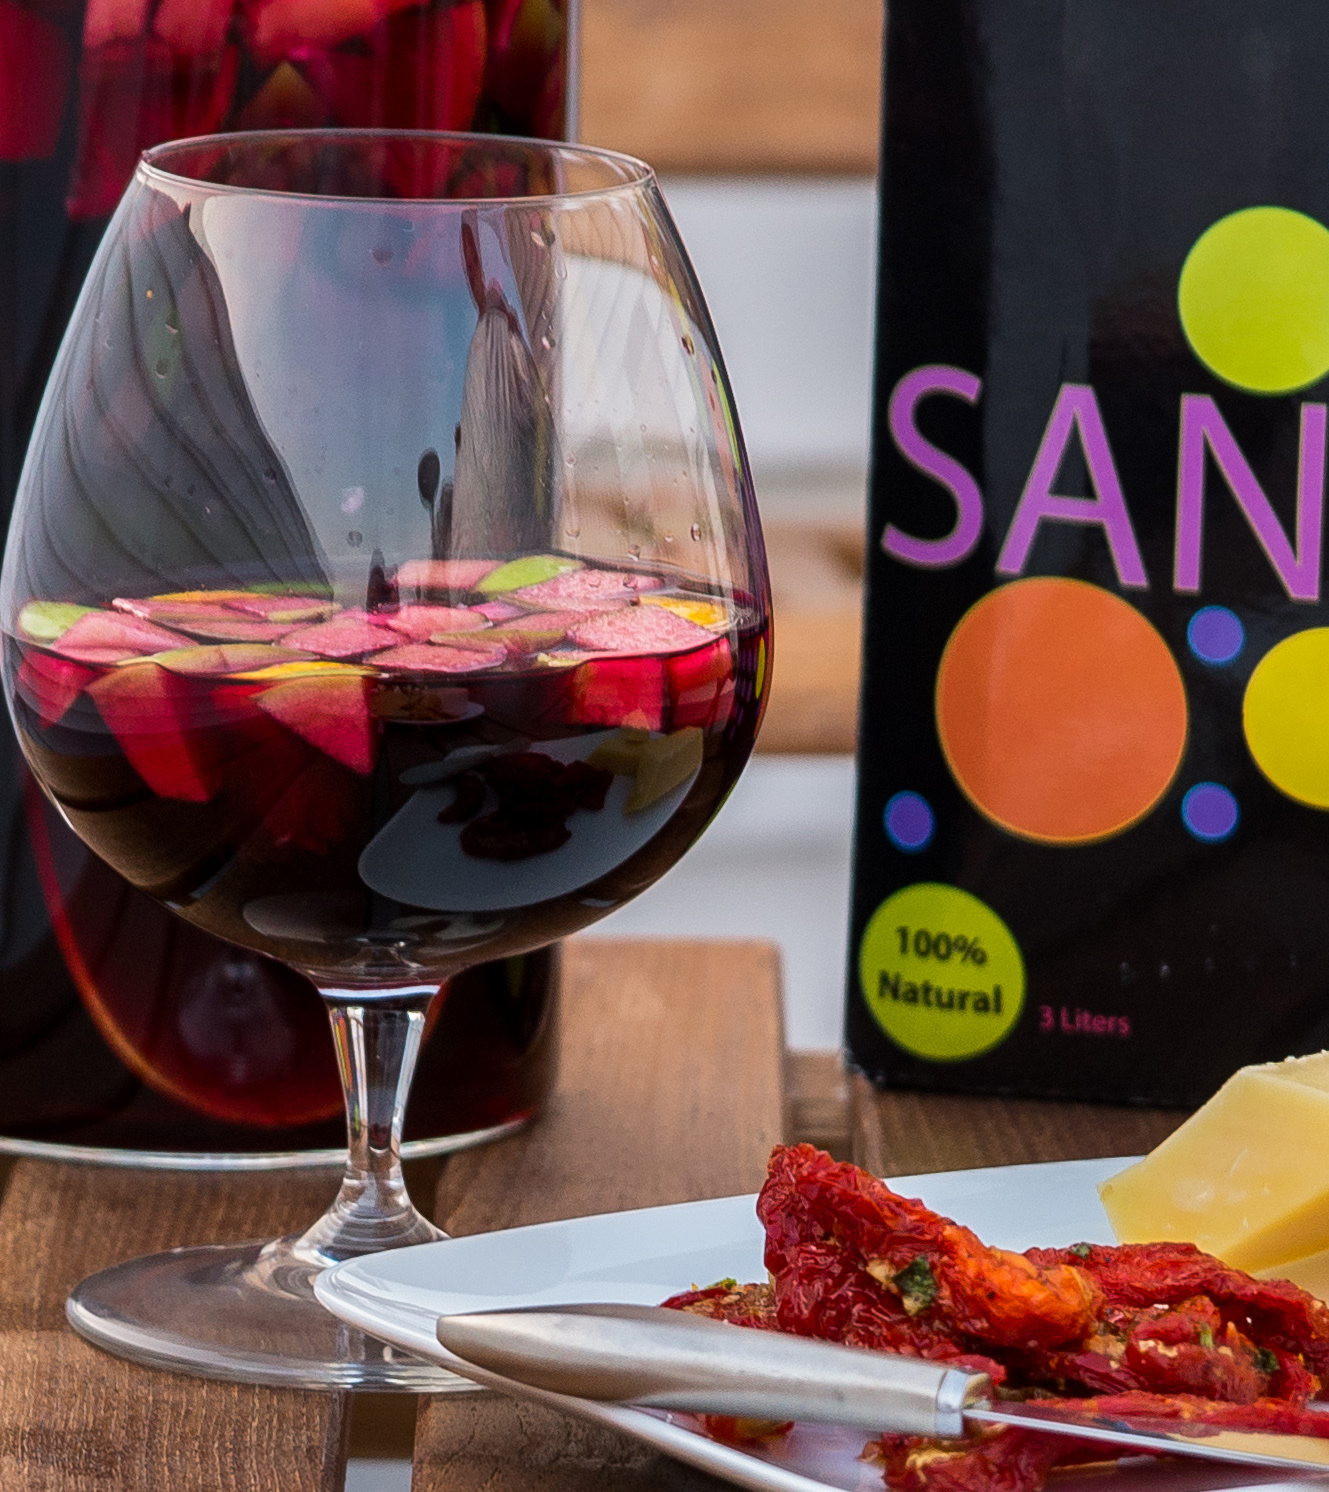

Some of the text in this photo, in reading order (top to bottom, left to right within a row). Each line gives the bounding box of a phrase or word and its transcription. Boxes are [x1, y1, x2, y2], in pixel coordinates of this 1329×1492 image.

[896, 925, 988, 968] 100%
[876, 969, 1004, 1015] Natural
[1038, 1004, 1133, 1038] 3 Liters
